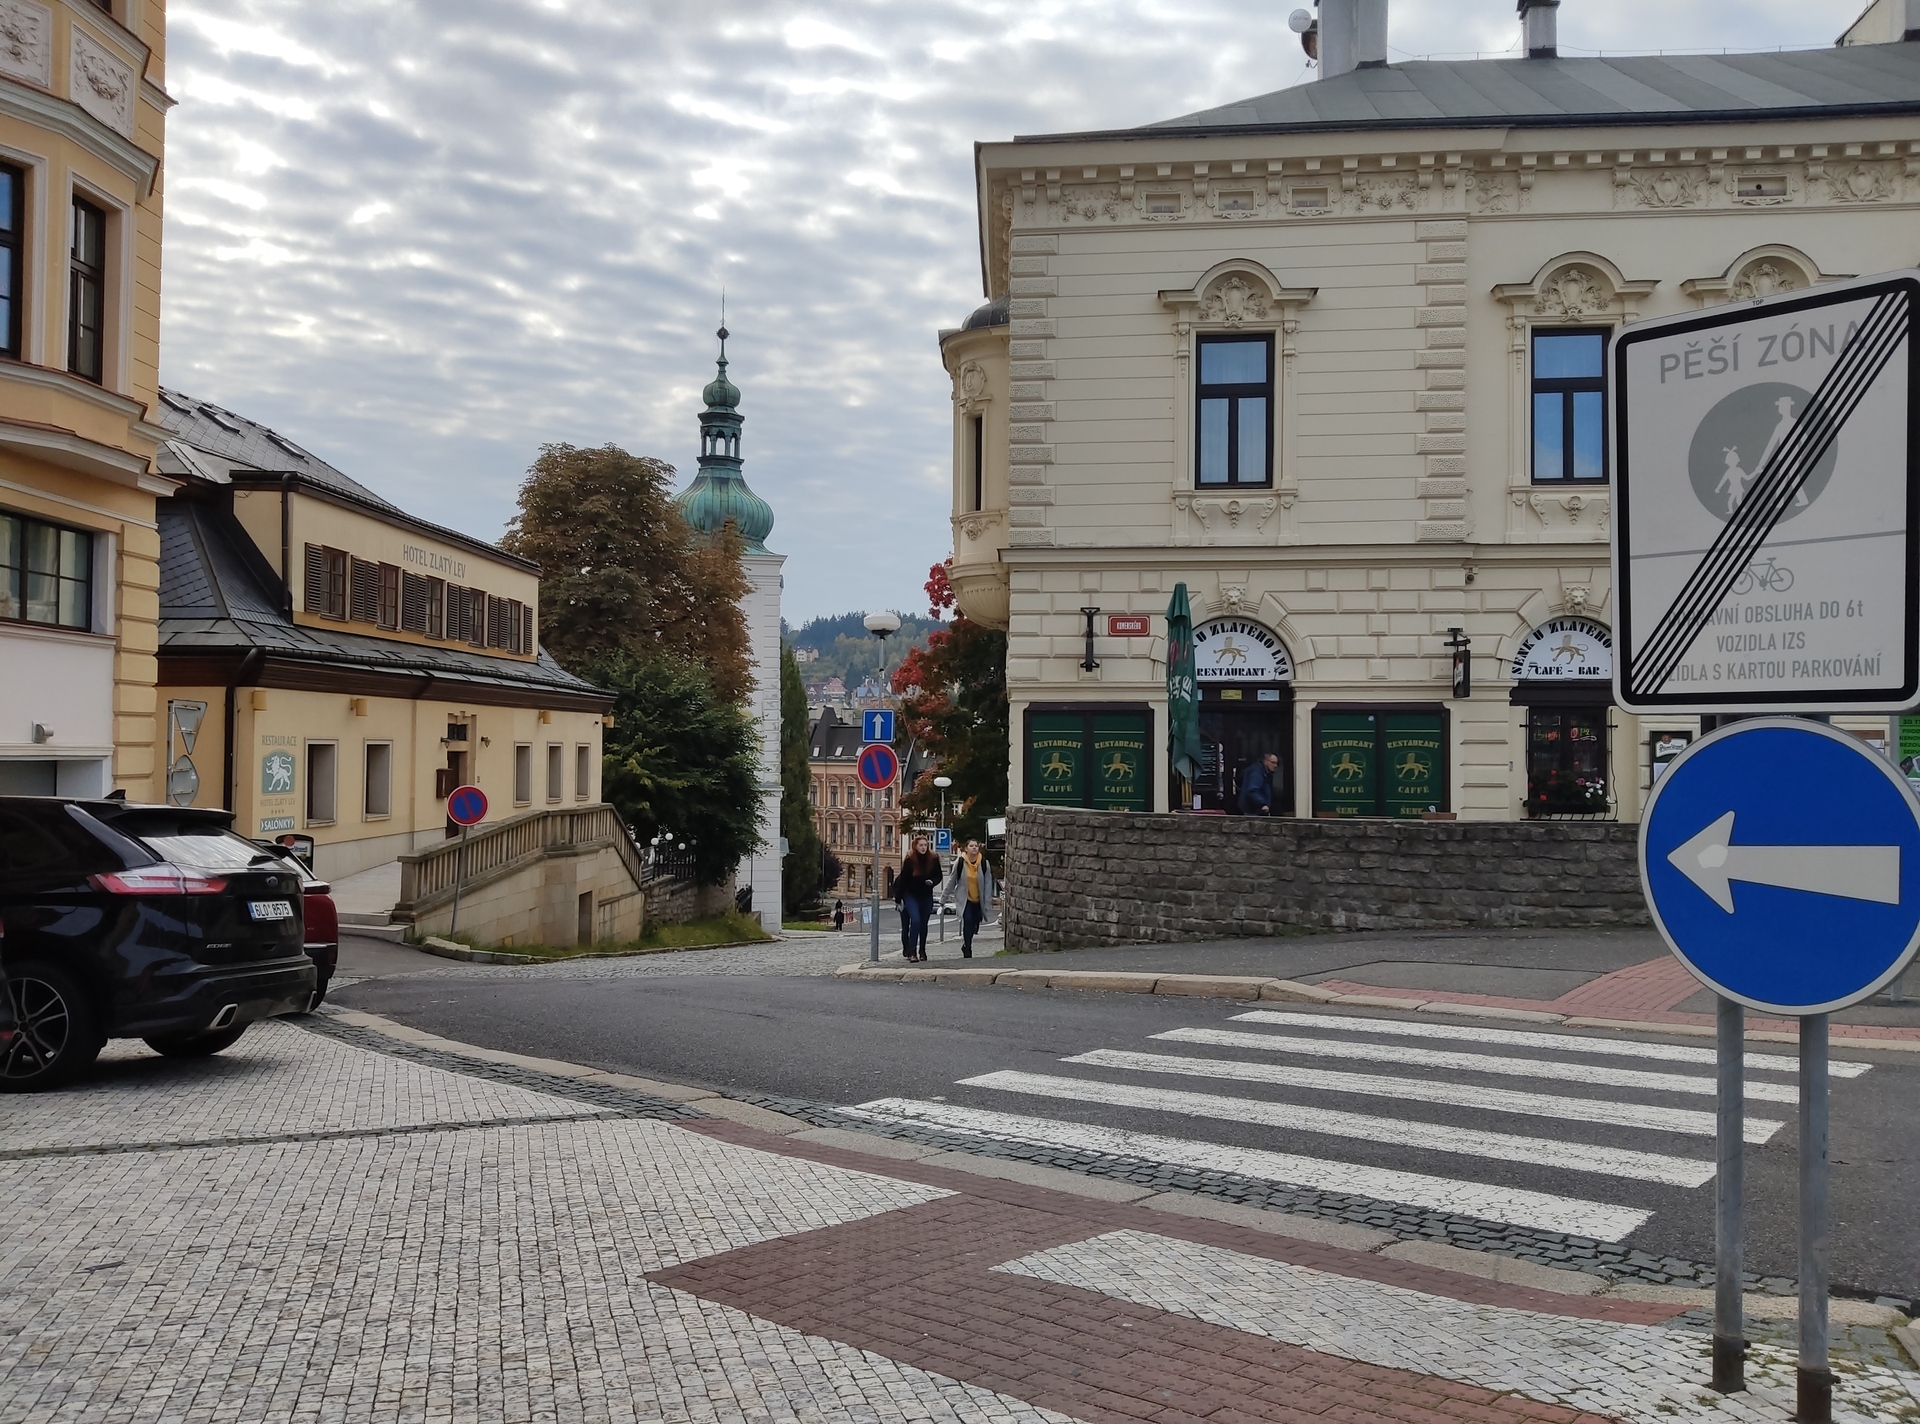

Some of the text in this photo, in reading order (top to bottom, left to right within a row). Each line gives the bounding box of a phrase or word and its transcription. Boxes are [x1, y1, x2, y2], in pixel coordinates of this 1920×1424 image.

[1660, 320, 1867, 384] PĚŠÍ ZÓNA
[403, 544, 466, 579] HOTEL ZLATÝ LEV
[1744, 602, 1814, 624] OBSLUHA
[1820, 600, 1840, 620] DO
[1209, 622, 1275, 649] ZLATÉHO
[1532, 629, 1545, 641] U
[1548, 620, 1612, 649] ZLATÉHO
[1716, 631, 1806, 653] VOZIDLA IZS
[1197, 668, 1266, 676] RESTAURANT
[1535, 664, 1563, 675] CAFÉ
[1578, 667, 1600, 675] BAR
[1713, 663, 1722, 680] S
[1727, 661, 1786, 680] KARTOU
[1792, 653, 1882, 678] PARKOVÁNÍ
[262, 735, 297, 746] RESTAURACE
[1033, 740, 1082, 749] RESTAURANT
[1094, 741, 1144, 750] RESTAURANT
[1322, 740, 1375, 749] RESTAURANT
[1386, 740, 1439, 749] RESTAURANT
[264, 817, 291, 831] SALÓNKY
[938, 831, 947, 844] P
